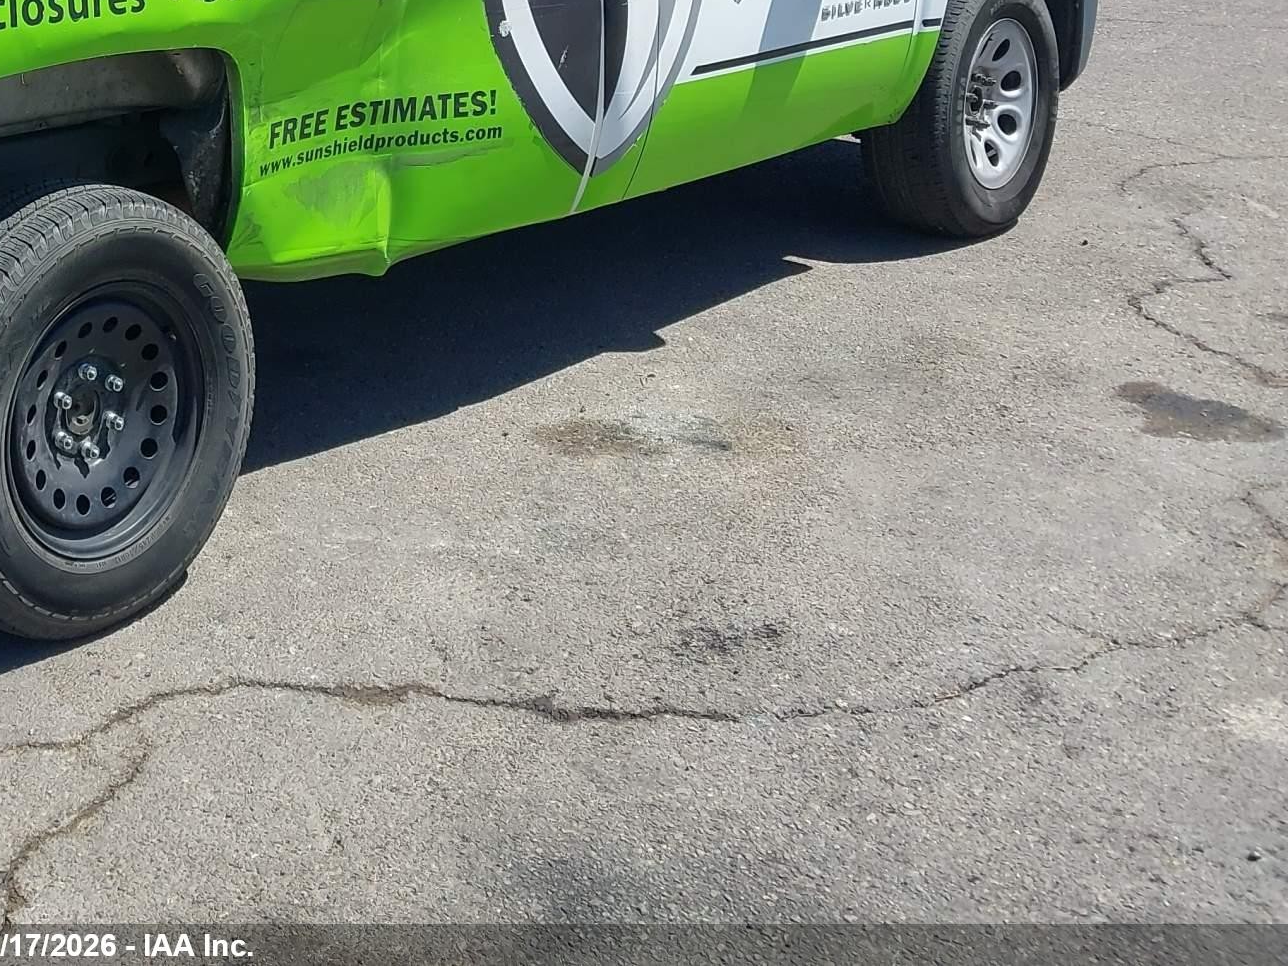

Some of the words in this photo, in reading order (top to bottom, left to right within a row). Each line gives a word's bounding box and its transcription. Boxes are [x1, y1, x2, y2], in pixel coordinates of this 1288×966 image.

[269, 108, 330, 150] FREE
[335, 89, 497, 132] ESTIMATES!
[259, 126, 503, 177] www.sunshieldproducts.com
